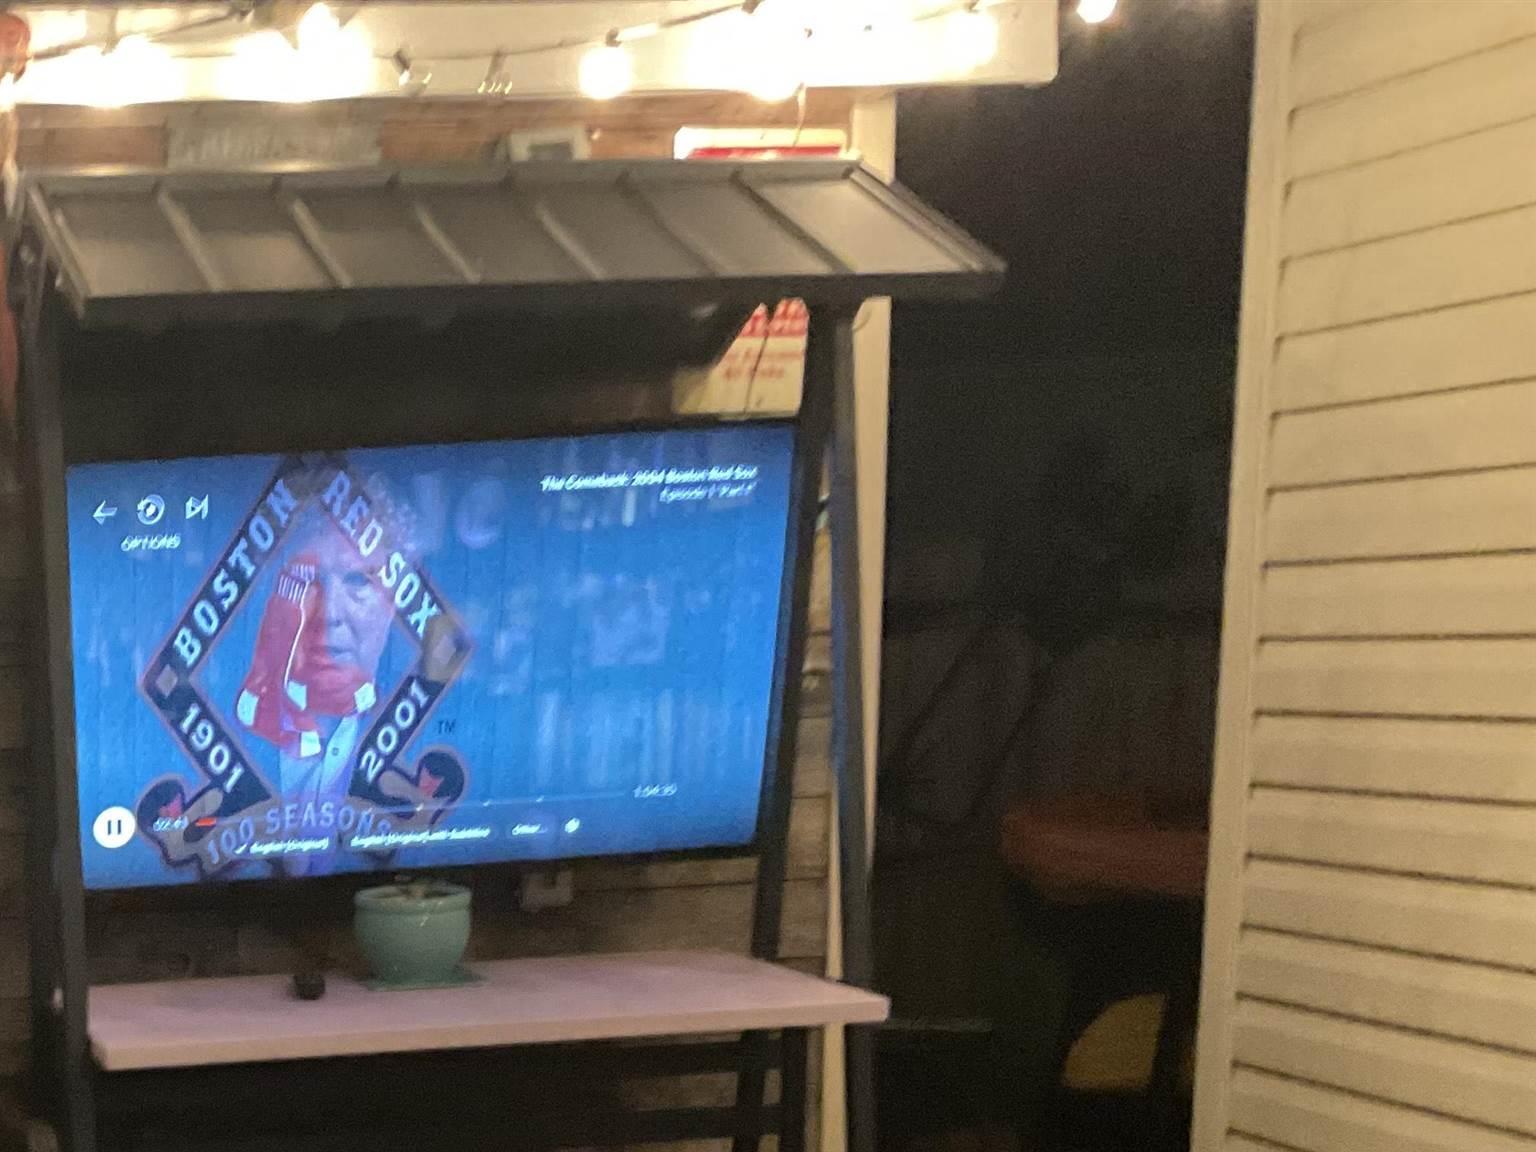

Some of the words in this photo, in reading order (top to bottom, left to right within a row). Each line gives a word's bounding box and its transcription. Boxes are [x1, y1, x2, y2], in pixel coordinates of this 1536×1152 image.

[173, 478, 298, 668] BOSTON
[320, 470, 384, 558] RED
[376, 550, 442, 636] SOX
[178, 703, 246, 795] 1901
[360, 684, 430, 785] 2001
[207, 817, 255, 865] 100
